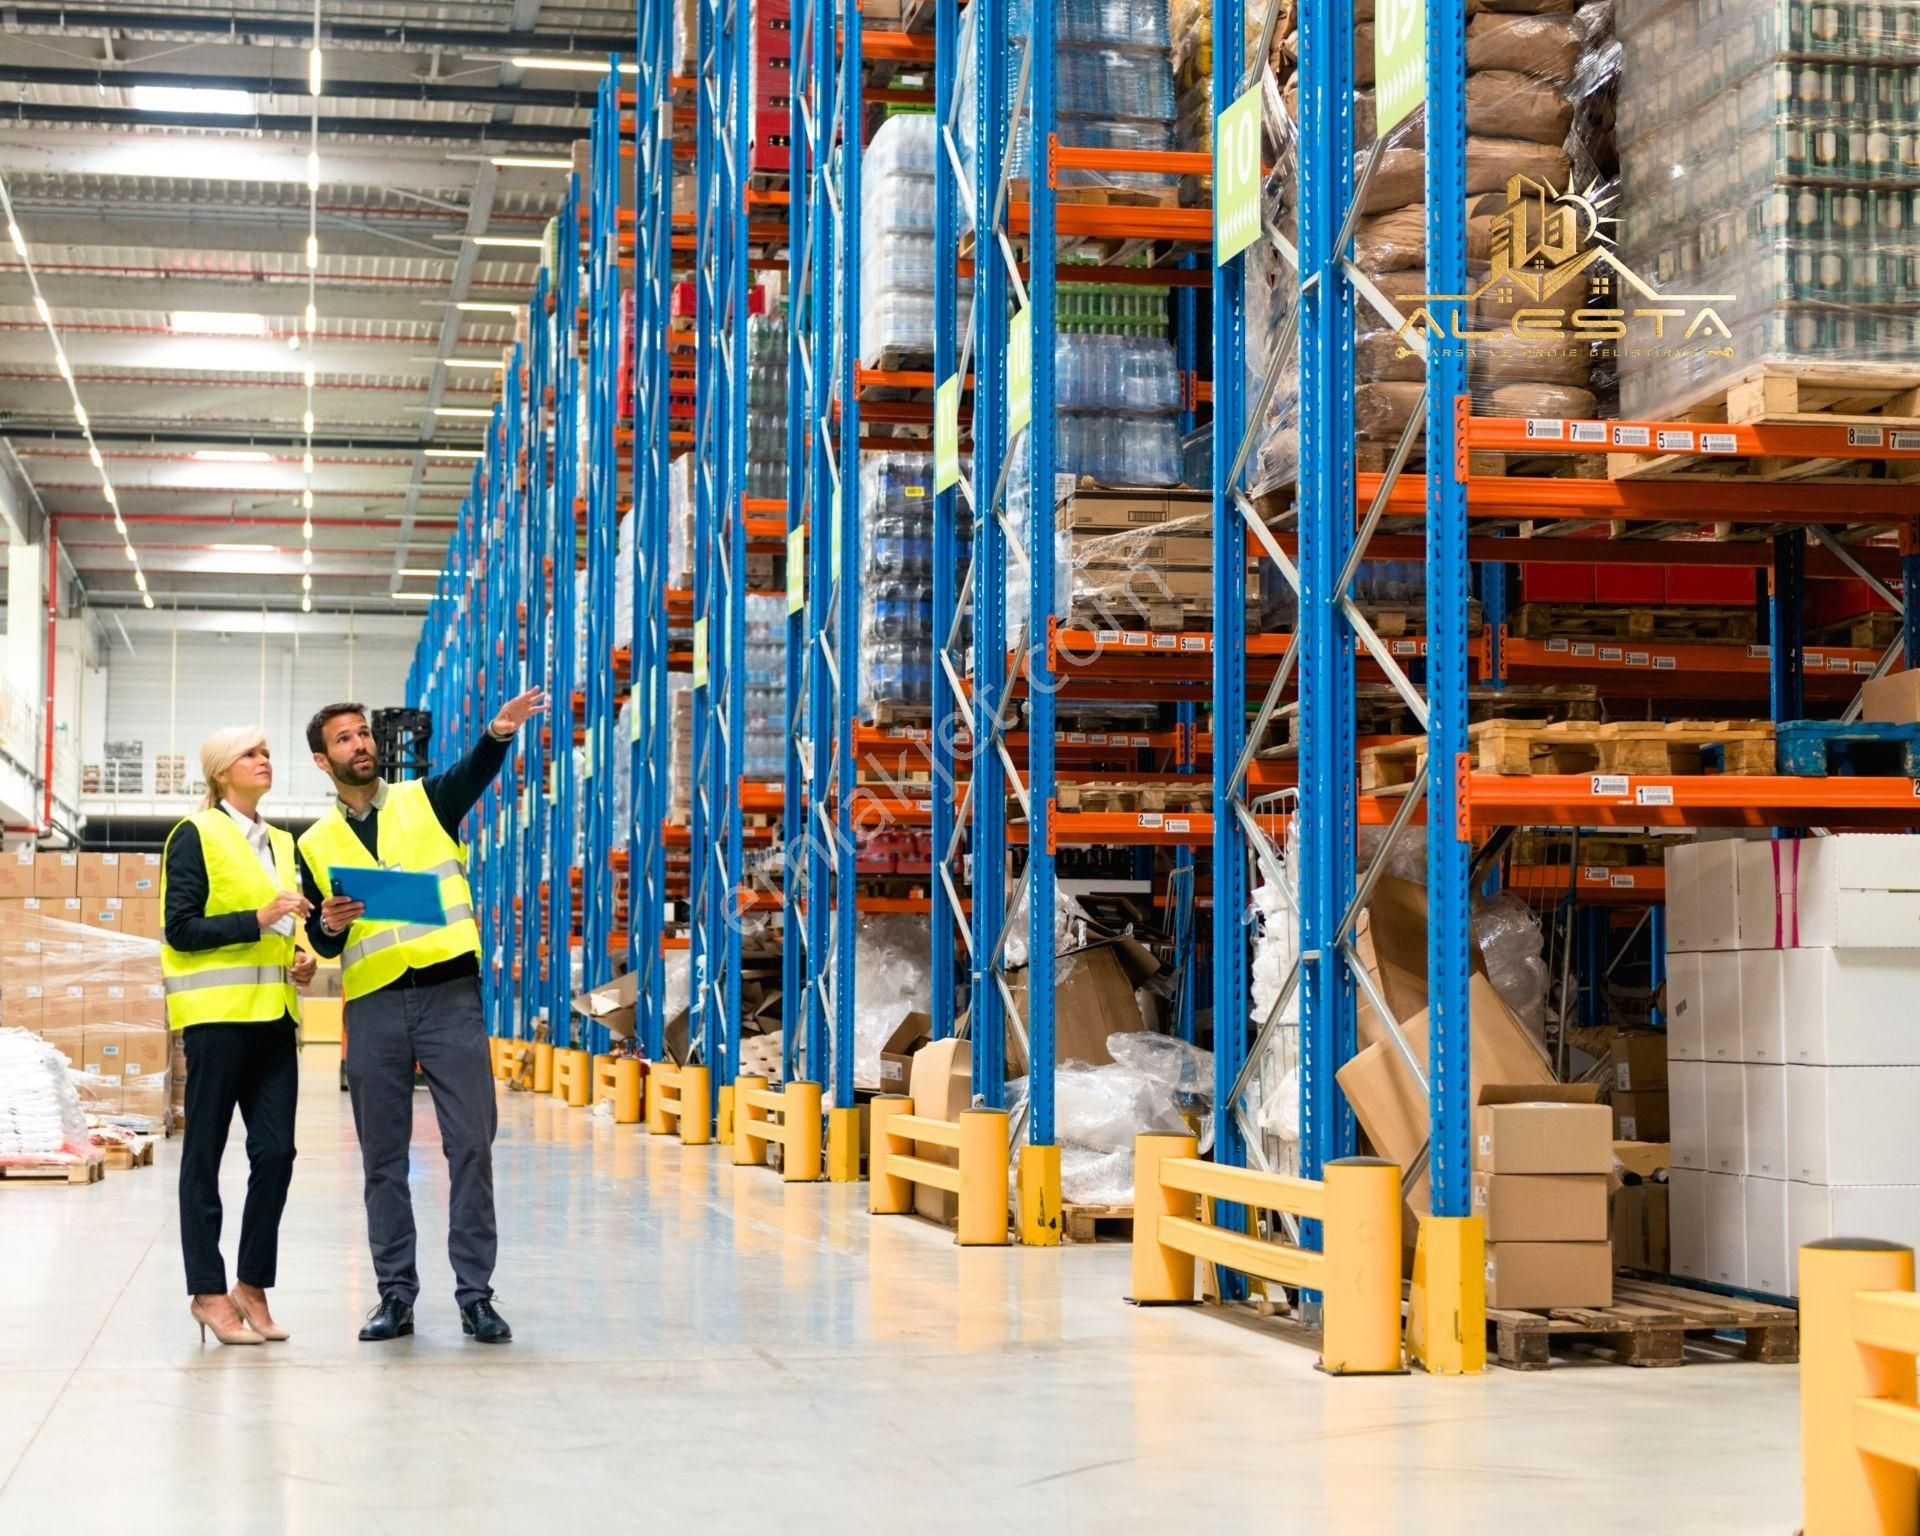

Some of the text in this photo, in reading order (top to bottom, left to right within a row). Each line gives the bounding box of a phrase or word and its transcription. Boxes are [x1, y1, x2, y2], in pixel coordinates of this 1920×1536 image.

[1224, 108, 1254, 195] 10
[1527, 420, 1534, 437] 8
[1571, 424, 1578, 440] 7
[1614, 427, 1621, 444] 6
[1848, 428, 1855, 444] 8
[1658, 432, 1665, 448] 5
[1701, 435, 1708, 450] 4
[1890, 432, 1897, 449] 7
[1181, 638, 1187, 649] 5
[1593, 777, 1600, 794] 2
[1638, 787, 1644, 804] 1
